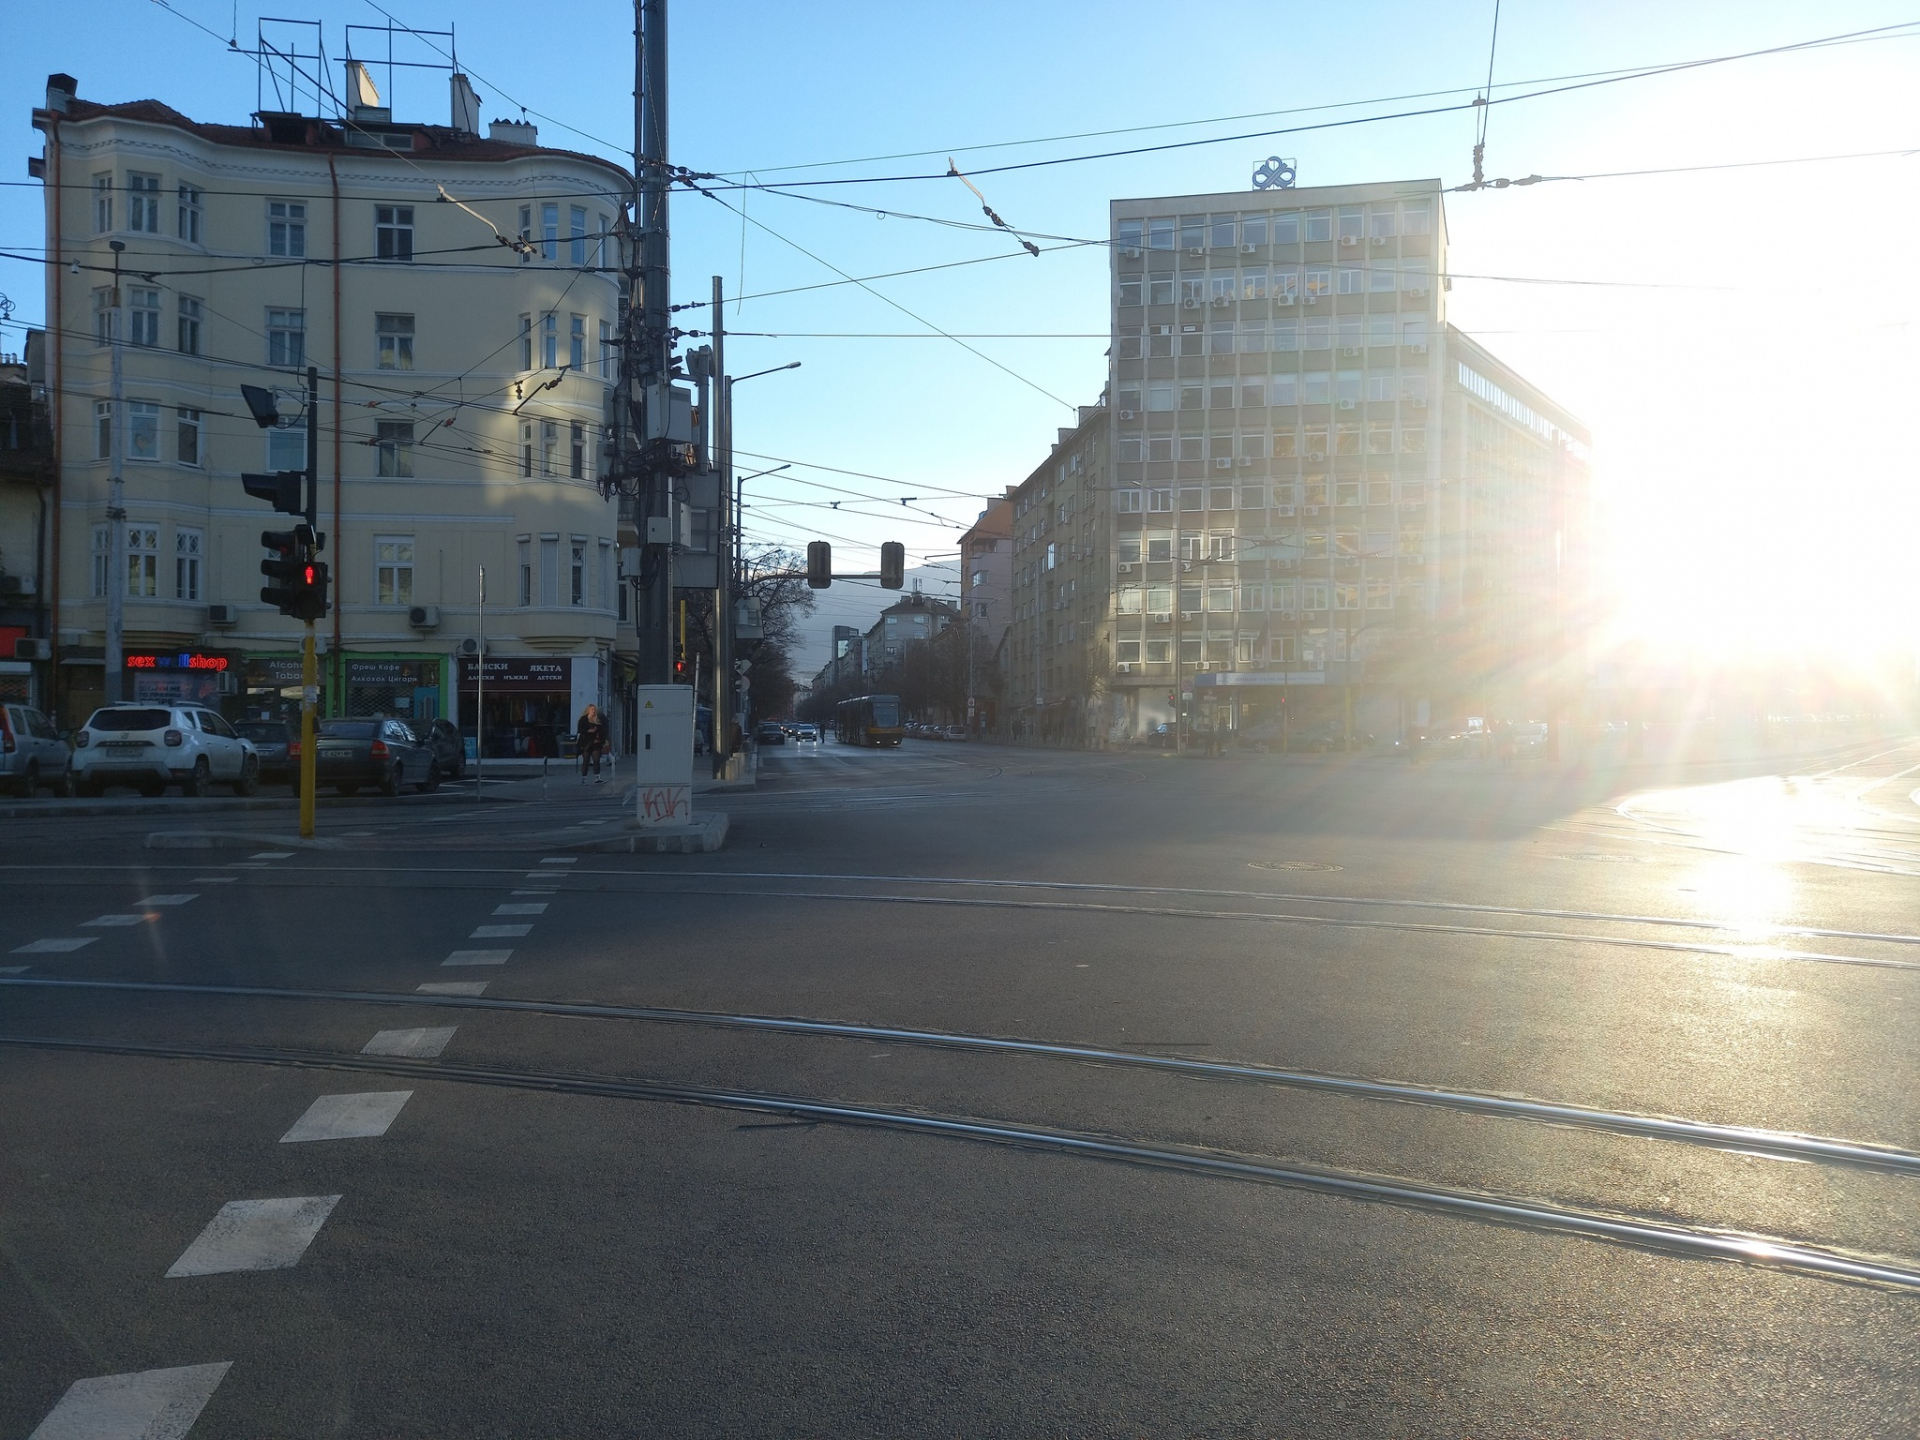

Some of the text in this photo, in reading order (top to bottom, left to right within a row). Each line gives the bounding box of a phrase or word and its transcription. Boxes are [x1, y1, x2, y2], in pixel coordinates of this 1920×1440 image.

[269, 661, 306, 669] Alcoho
[351, 663, 400, 671] Фреш Кафе
[529, 664, 563, 672] ЯКЕТА
[275, 671, 320, 680] Tobaco
[387, 675, 418, 683] Цигари
